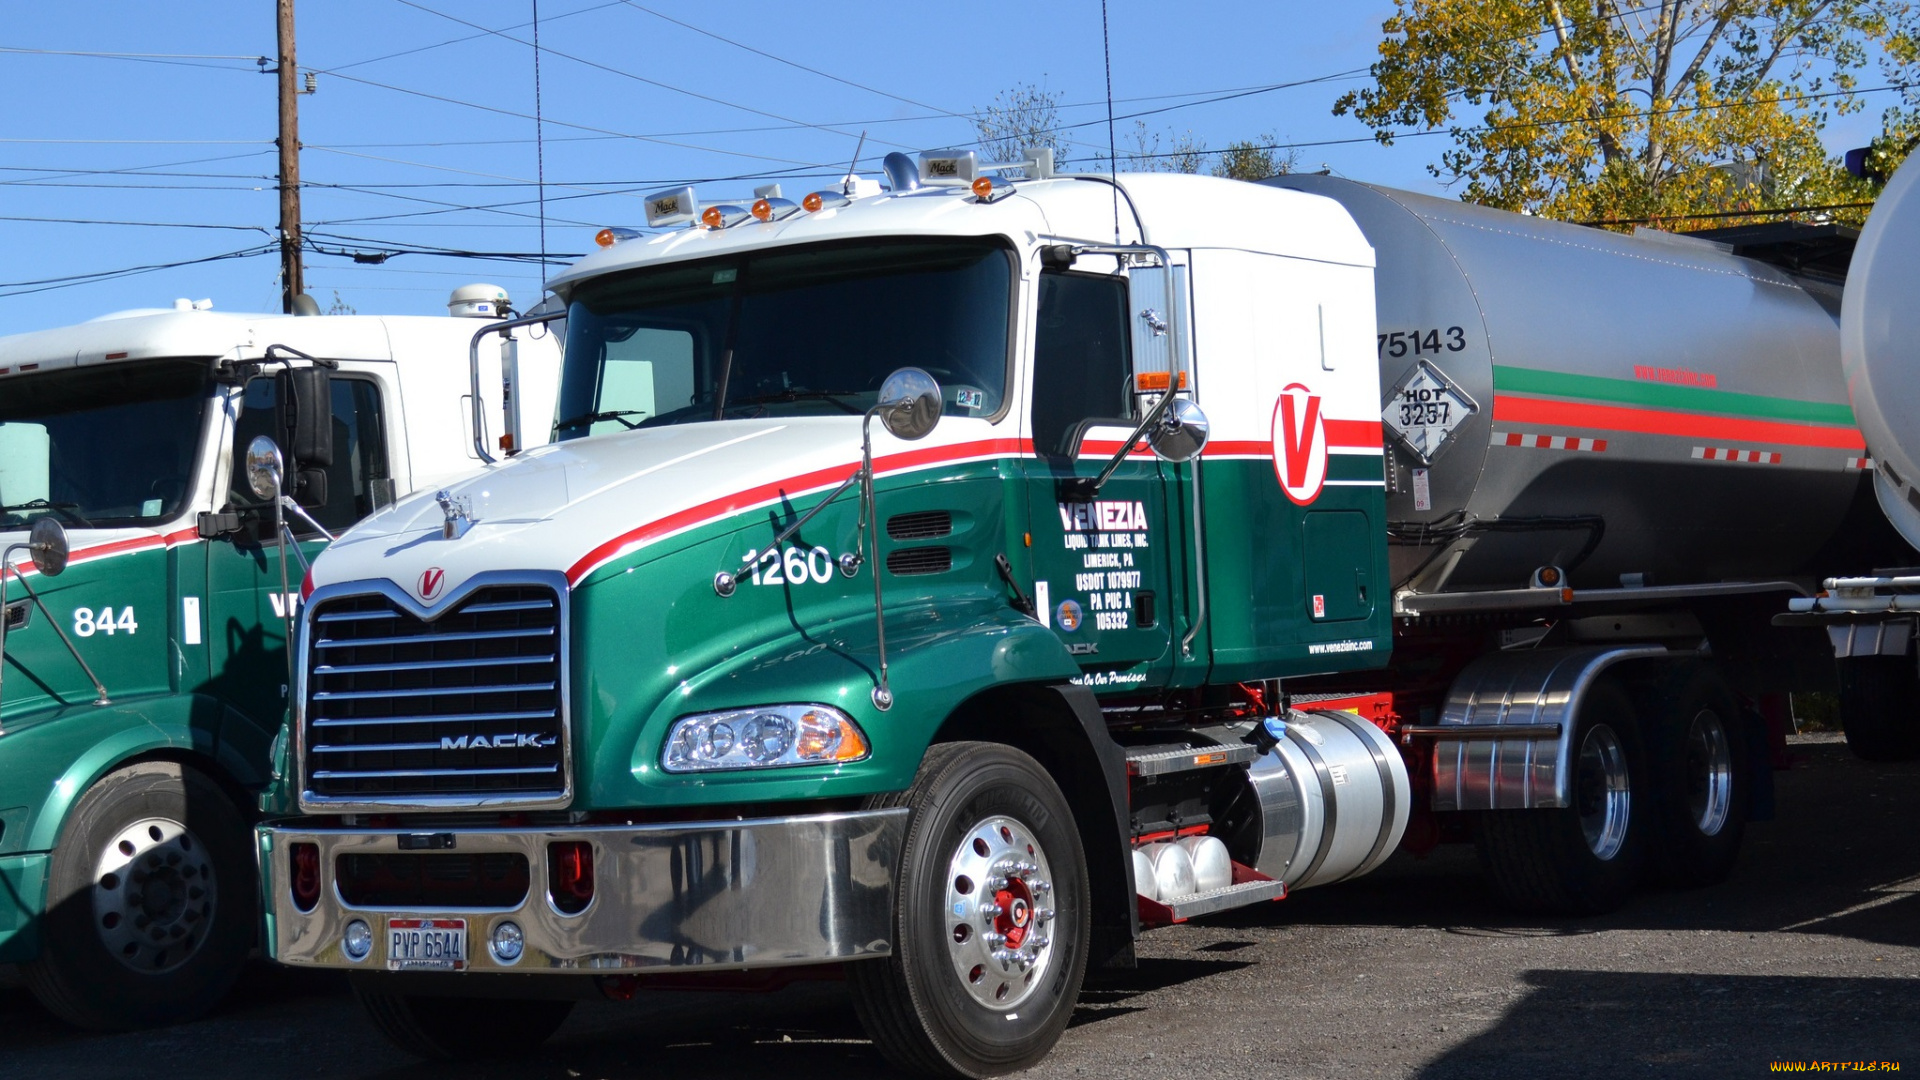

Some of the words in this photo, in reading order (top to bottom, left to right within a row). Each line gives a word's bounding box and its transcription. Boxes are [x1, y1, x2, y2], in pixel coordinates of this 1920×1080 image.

[930, 161, 956, 174] Mack
[655, 199, 678, 214] Mack
[1406, 389, 1444, 402] HOT
[1400, 402, 1450, 426] 3257
[1280, 394, 1321, 488] V
[1059, 501, 1148, 531] VENEZIA
[1064, 533, 1088, 550] LIQUID
[1090, 534, 1110, 548] TANK
[1111, 533, 1133, 549] LINES,
[1134, 533, 1149, 548] INC.
[742, 546, 833, 585] 1260
[1083, 553, 1121, 569] LIMERICK,
[1123, 552, 1134, 567] PA
[423, 570, 444, 596] V
[1076, 572, 1105, 591] USDOT
[1107, 570, 1141, 589] 1079977
[1090, 592, 1103, 610] PA
[1105, 592, 1122, 609] PUC
[1125, 591, 1132, 609] A
[74, 606, 138, 637] 844
[1096, 611, 1128, 630] 105332
[1308, 640, 1373, 654] www.veneziainc.com
[1084, 673, 1094, 686] On
[1095, 672, 1108, 685] Our
[441, 733, 542, 750] MACK
[393, 932, 420, 958] PVP
[425, 932, 460, 958] 6544
